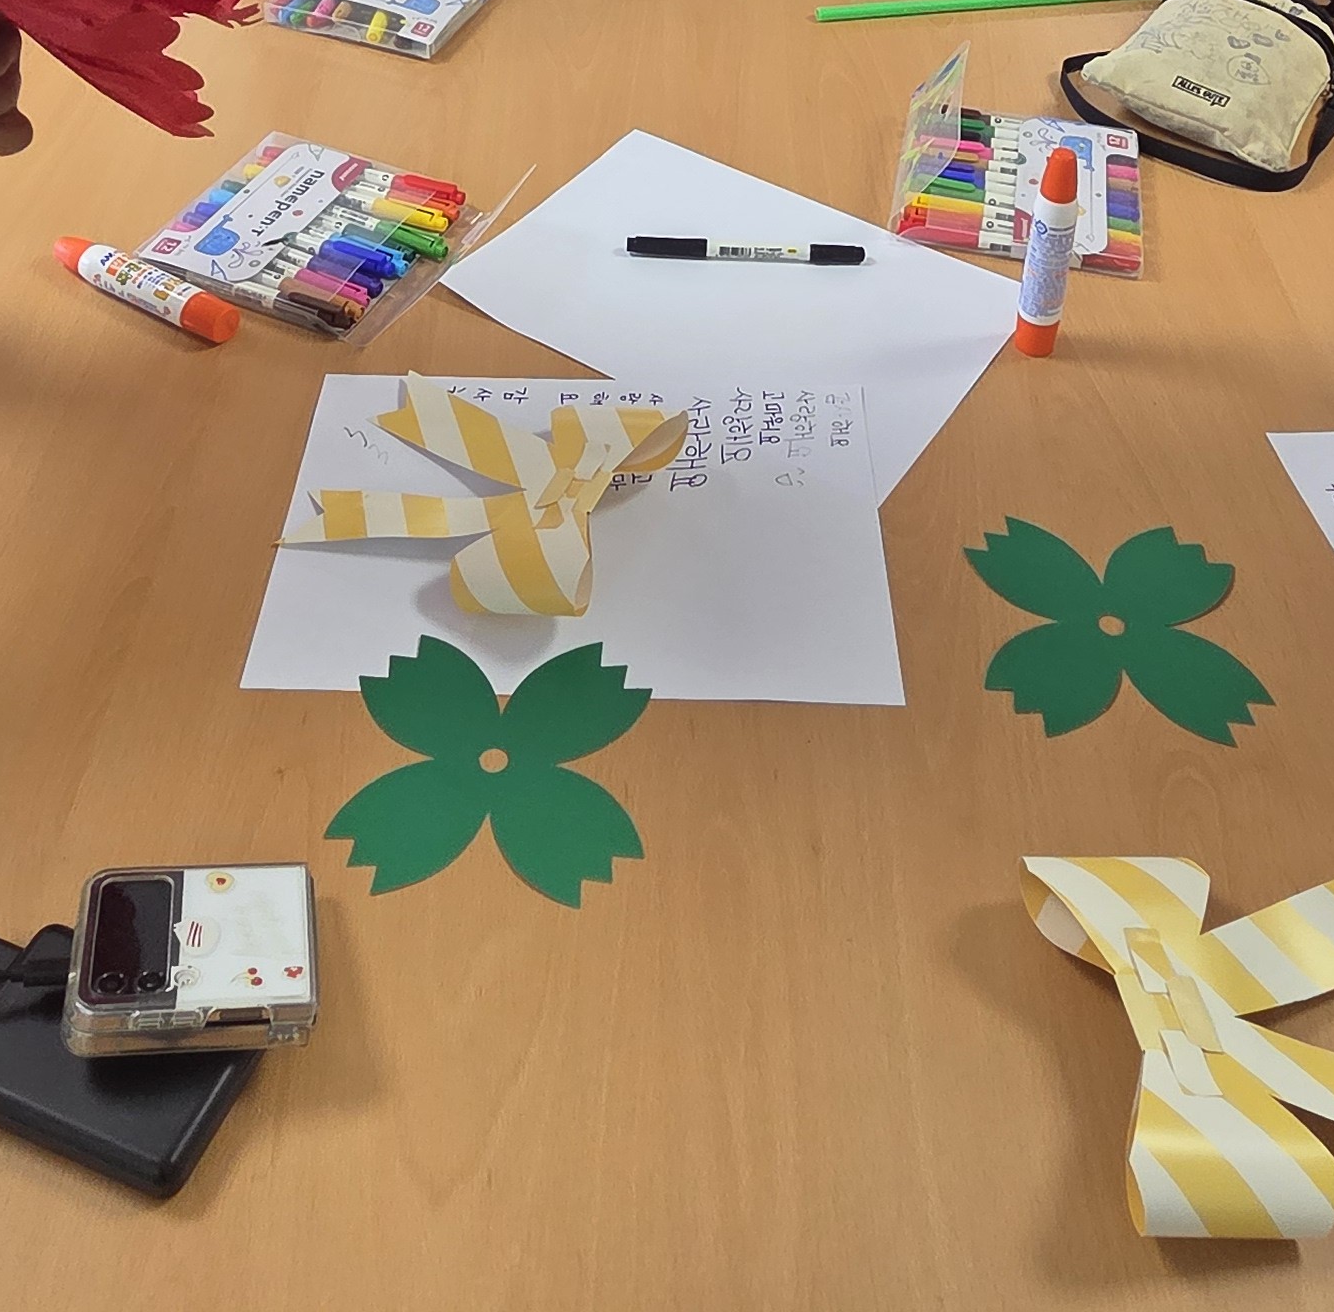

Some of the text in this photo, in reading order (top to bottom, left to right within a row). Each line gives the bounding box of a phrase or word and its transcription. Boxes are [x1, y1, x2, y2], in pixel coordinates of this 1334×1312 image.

[1178, 78, 1202, 96] ALLES
[560, 391, 664, 406] 사랑해요
[721, 387, 754, 464] 사랑해요
[759, 390, 785, 445] 고마워요
[780, 389, 816, 458] 사랑해요
